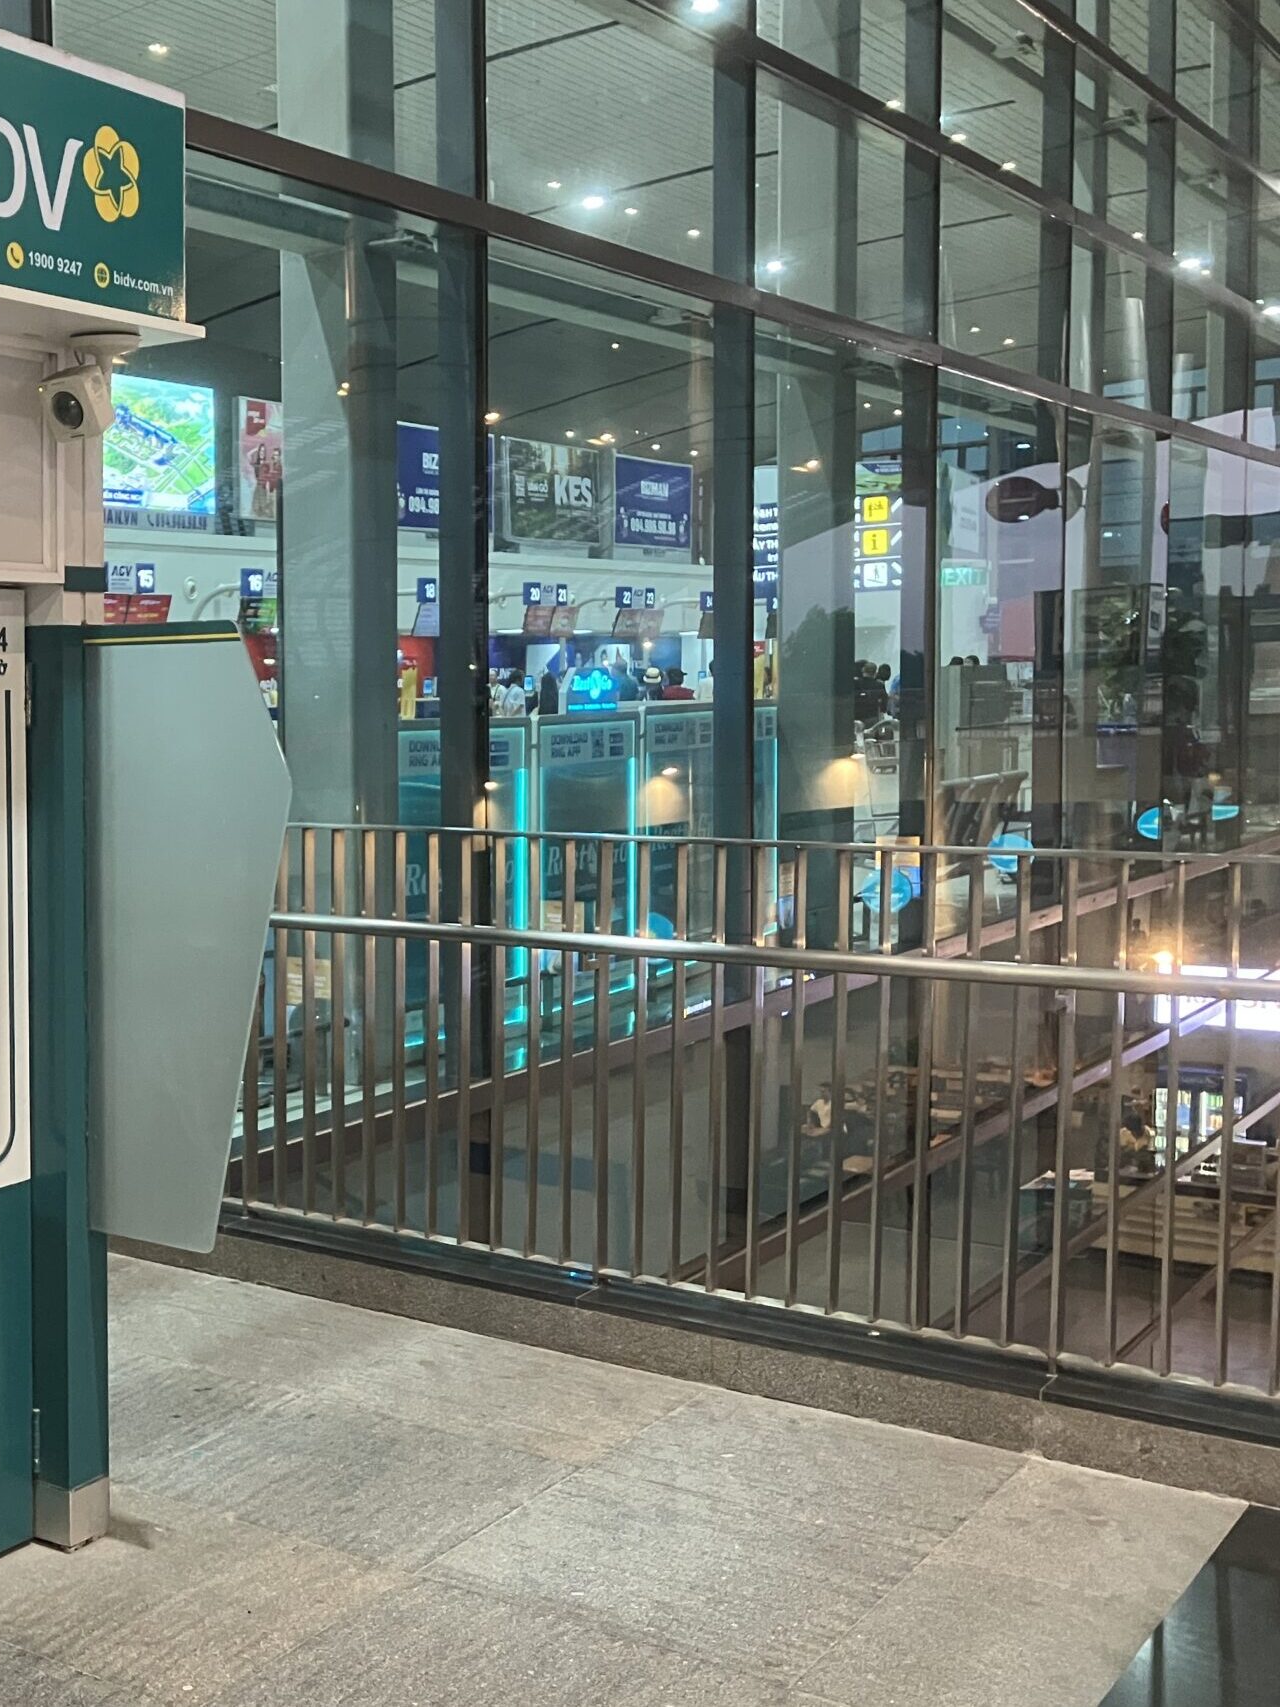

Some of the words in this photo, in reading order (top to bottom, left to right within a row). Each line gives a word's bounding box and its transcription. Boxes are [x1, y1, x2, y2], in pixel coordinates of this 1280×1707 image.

[28, 250, 55, 271] 1900
[57, 257, 83, 277] 9247
[112, 270, 174, 297] bidv.com.vn
[553, 474, 593, 509] KES
[137, 569, 154, 588] 15
[248, 573, 263, 592] 16
[944, 567, 983, 587] EXIT
[424, 583, 436, 599] 18
[529, 587, 541, 602] 20
[557, 588, 568, 602] 21
[622, 591, 632, 605] 22
[646, 592, 655, 605] 23
